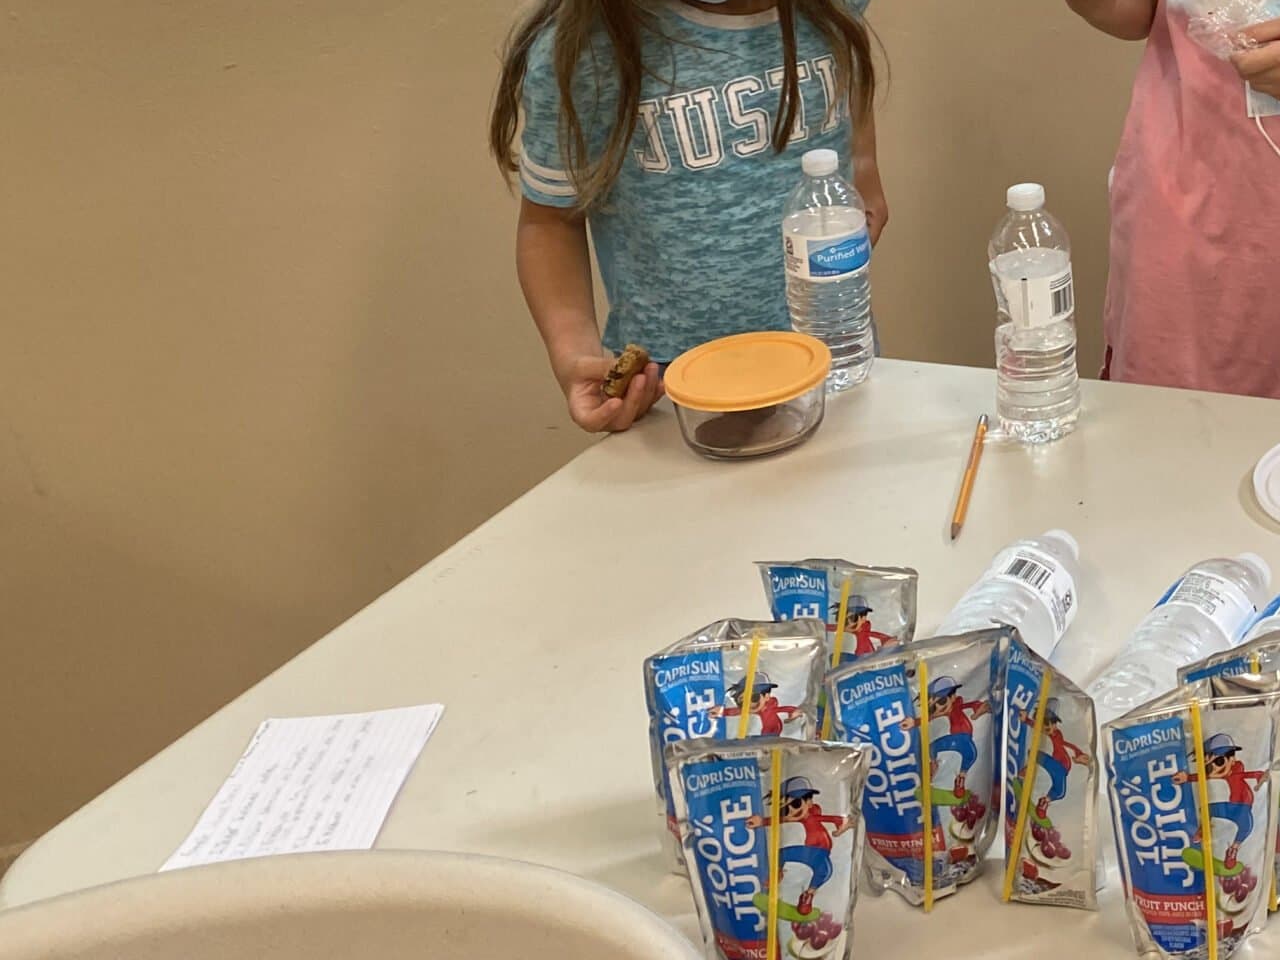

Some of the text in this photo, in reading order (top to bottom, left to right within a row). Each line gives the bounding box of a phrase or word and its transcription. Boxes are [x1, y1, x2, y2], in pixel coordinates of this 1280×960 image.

[634, 54, 842, 174] JUSTI
[817, 247, 854, 263] Purified
[874, 700, 925, 824] JUICE
[694, 814, 732, 909] 100%
[719, 794, 766, 932] JUICE
[900, 831, 941, 849] PUNH
[1120, 775, 1161, 867] 100%
[1147, 753, 1196, 888] JUICE
[1163, 900, 1206, 912] PUNCH
